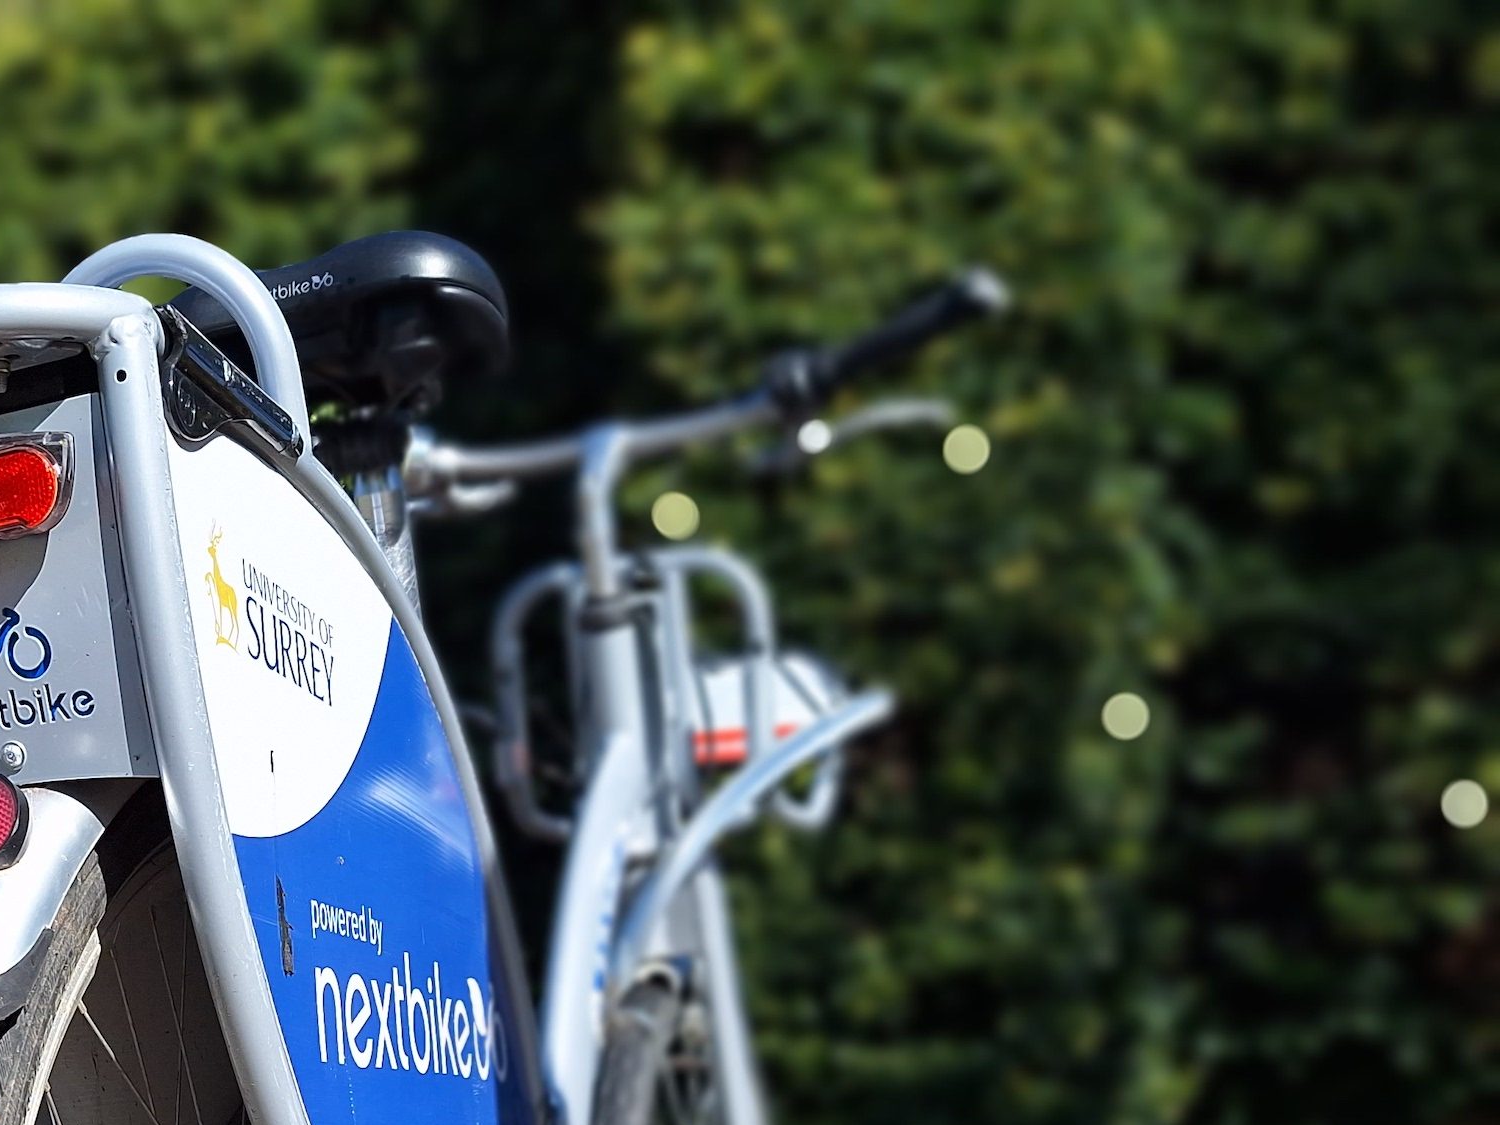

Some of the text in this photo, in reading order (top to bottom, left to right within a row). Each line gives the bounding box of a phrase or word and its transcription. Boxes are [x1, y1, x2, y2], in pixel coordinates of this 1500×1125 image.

[242, 558, 334, 648] UNIVERSITY OF
[246, 596, 334, 707] SURREY
[310, 899, 383, 956] powered by
[314, 951, 473, 1079] nextbike
